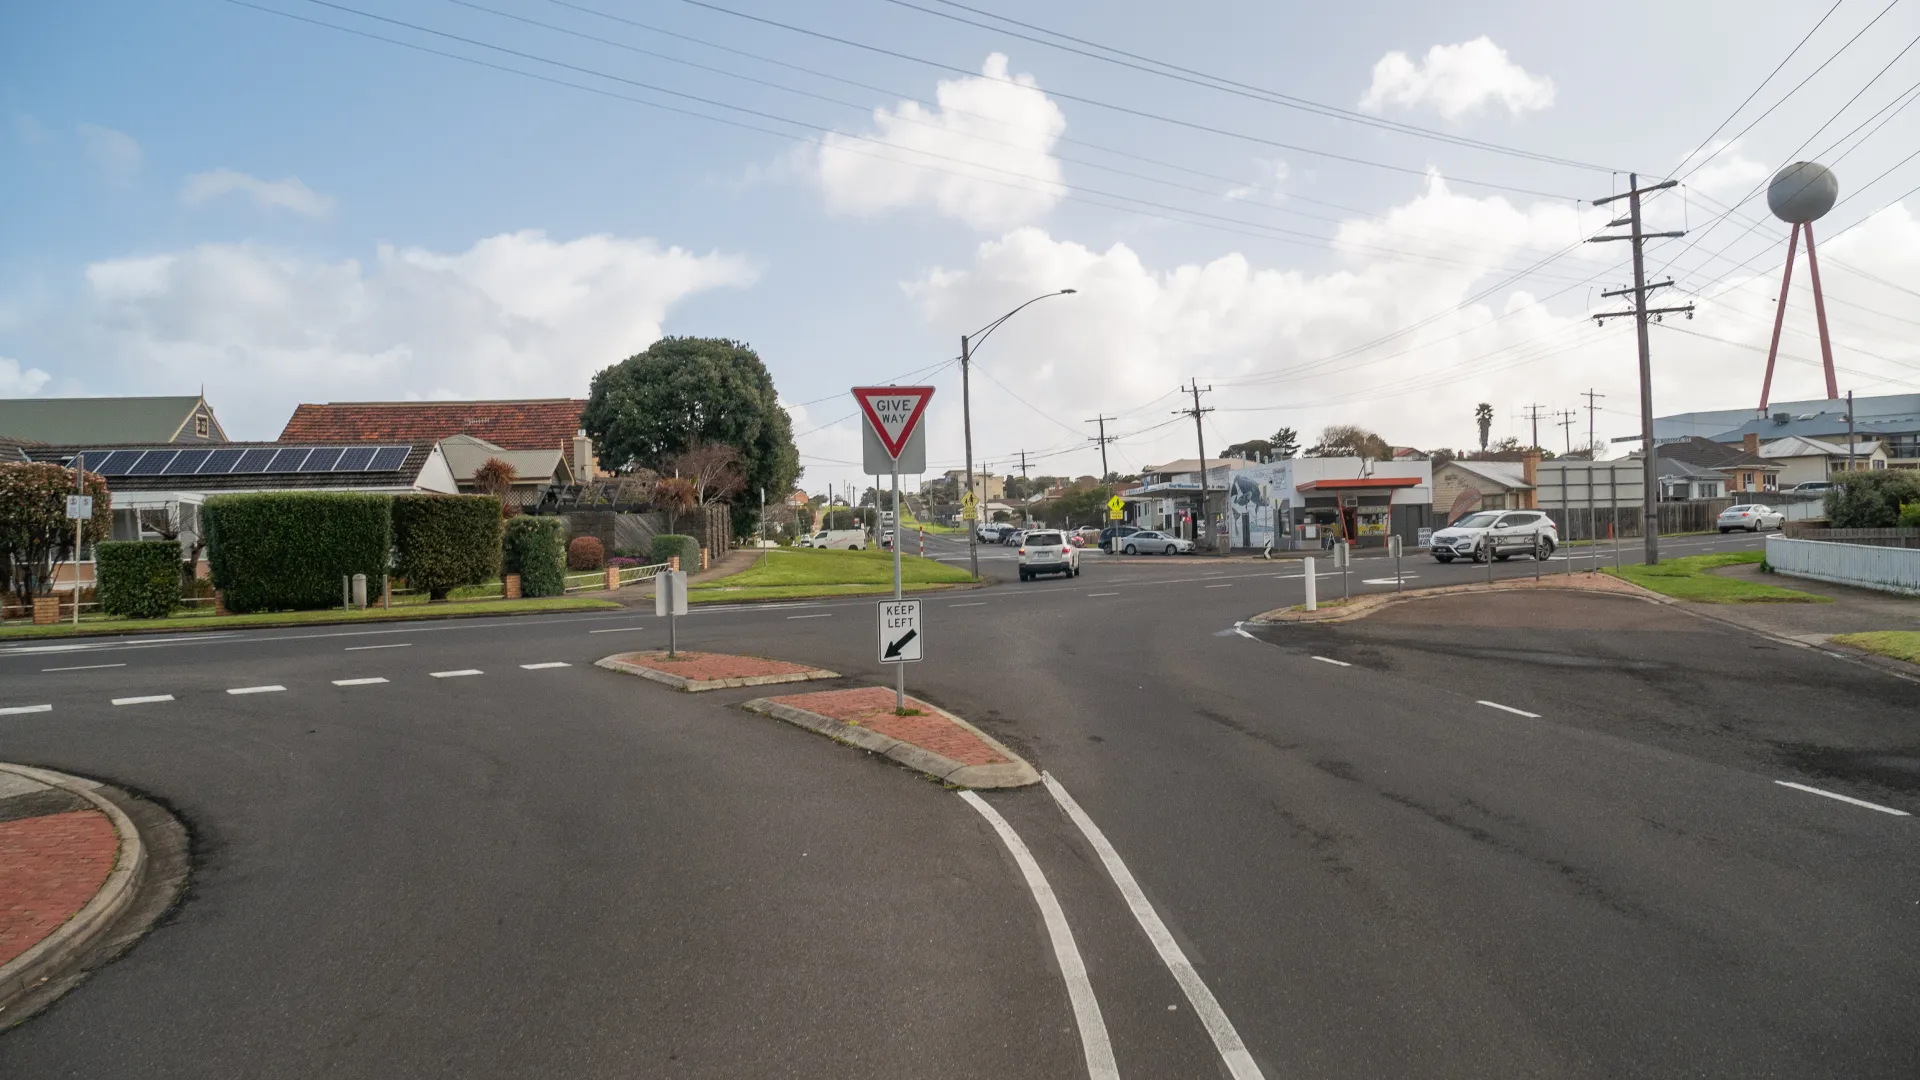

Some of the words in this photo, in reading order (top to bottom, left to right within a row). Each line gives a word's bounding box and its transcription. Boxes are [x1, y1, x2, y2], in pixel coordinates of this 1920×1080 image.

[876, 399, 911, 411] GIVE
[882, 414, 906, 423] WAY
[886, 605, 914, 615] KEEP
[888, 618, 913, 628] LEFT
